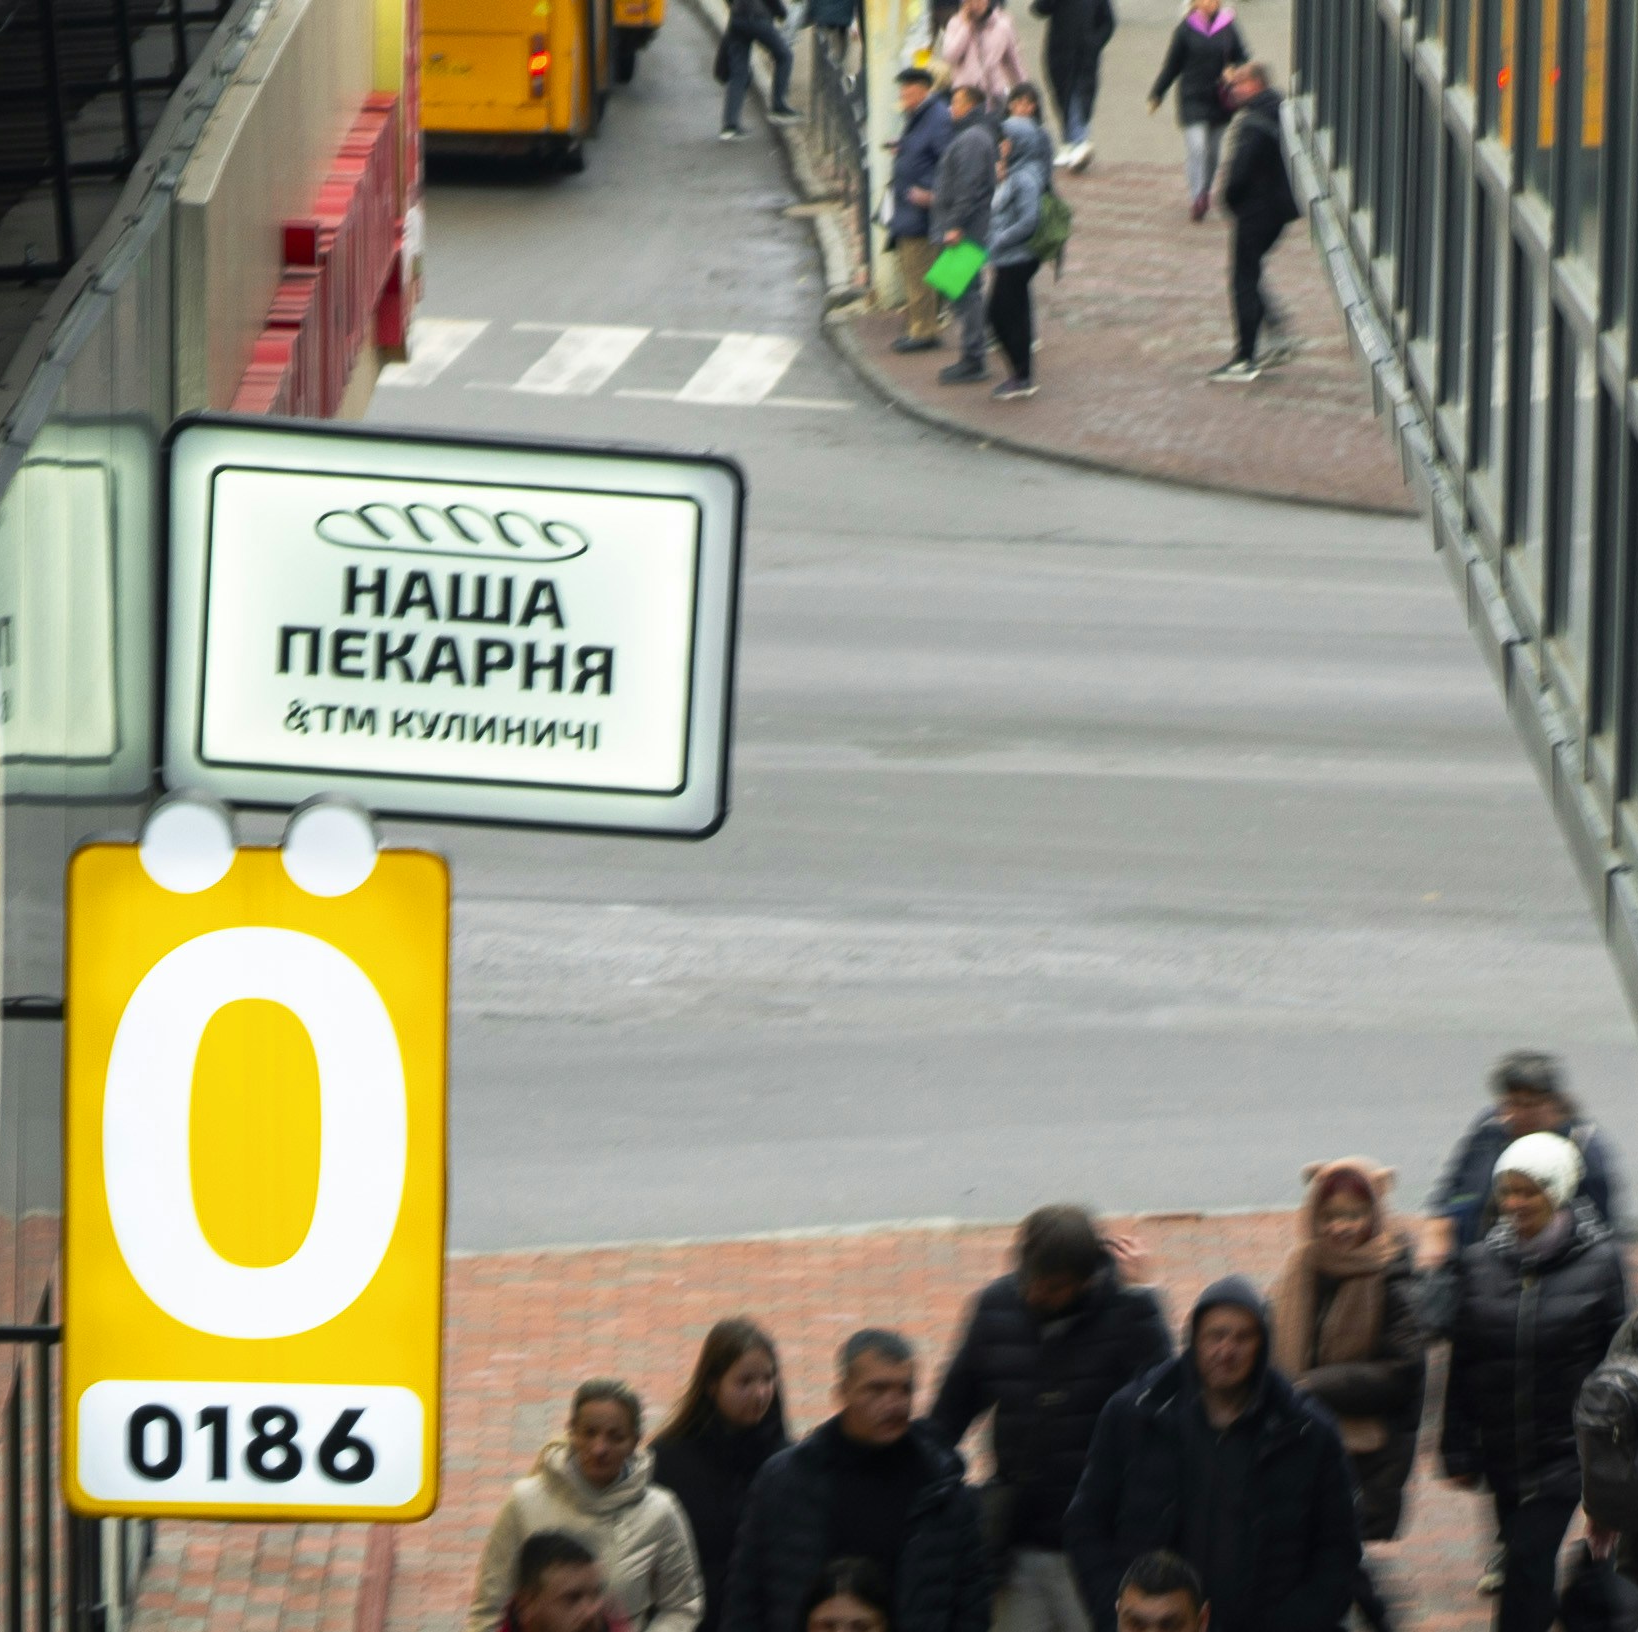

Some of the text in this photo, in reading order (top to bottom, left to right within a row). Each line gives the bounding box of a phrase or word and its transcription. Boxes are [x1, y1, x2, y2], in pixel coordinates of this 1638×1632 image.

[340, 565, 566, 629] НАША
[275, 625, 615, 696] ПЕКАРНЯ
[390, 708, 600, 751] КУЛИНИЧІ
[125, 1403, 376, 1484] 0186
